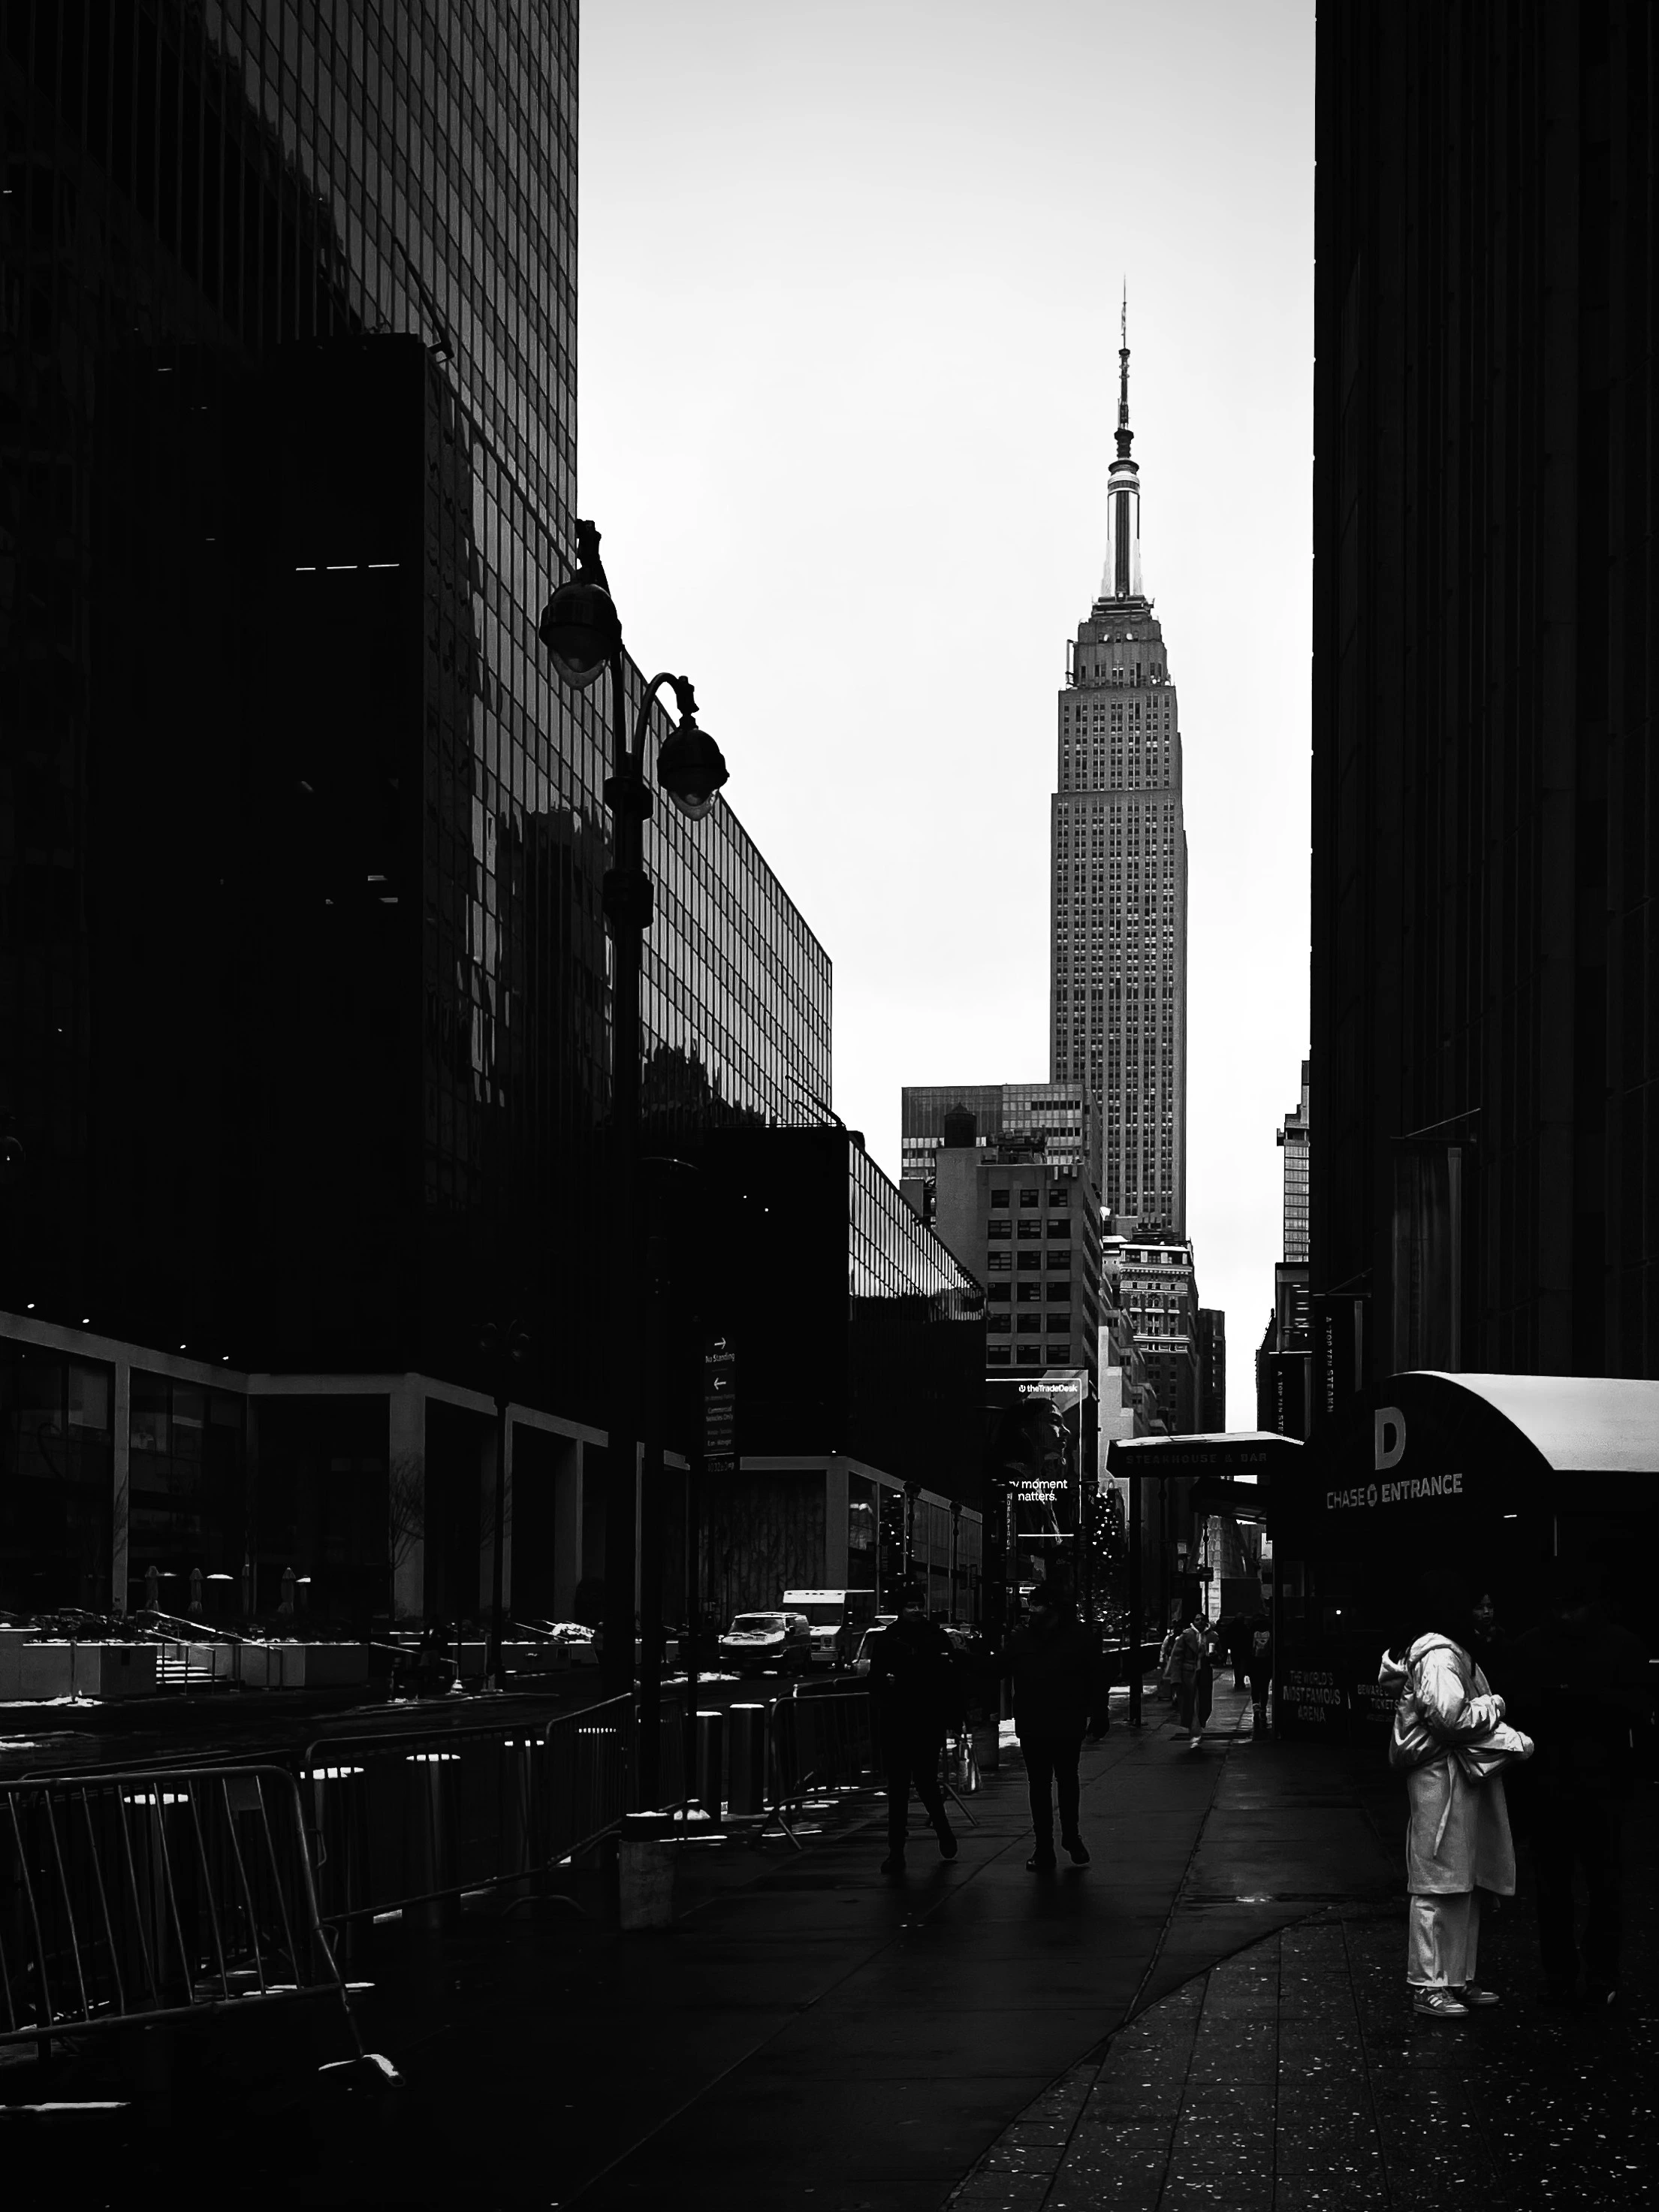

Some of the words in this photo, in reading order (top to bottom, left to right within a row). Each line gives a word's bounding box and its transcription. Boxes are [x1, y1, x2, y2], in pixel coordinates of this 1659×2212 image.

[713, 1352, 735, 1363] Standing
[1374, 1406, 1406, 1471] D
[1126, 1453, 1217, 1464] STEAKHOUSE
[1225, 1454, 1233, 1462] &
[1240, 1453, 1268, 1462] BAR
[1021, 1479, 1068, 1489] moment
[1326, 1487, 1365, 1509] CHASE
[1381, 1473, 1463, 1503] ENTRANCE
[1289, 1670, 1302, 1684] THE
[1303, 1671, 1334, 1685] WORLD'S
[1283, 1685, 1305, 1702] MOST
[1305, 1687, 1341, 1705] FAMOUS
[1357, 1684, 1383, 1696] BEWARE
[1371, 1697, 1399, 1710] TICKETS
[1298, 1705, 1327, 1722] ARENA
